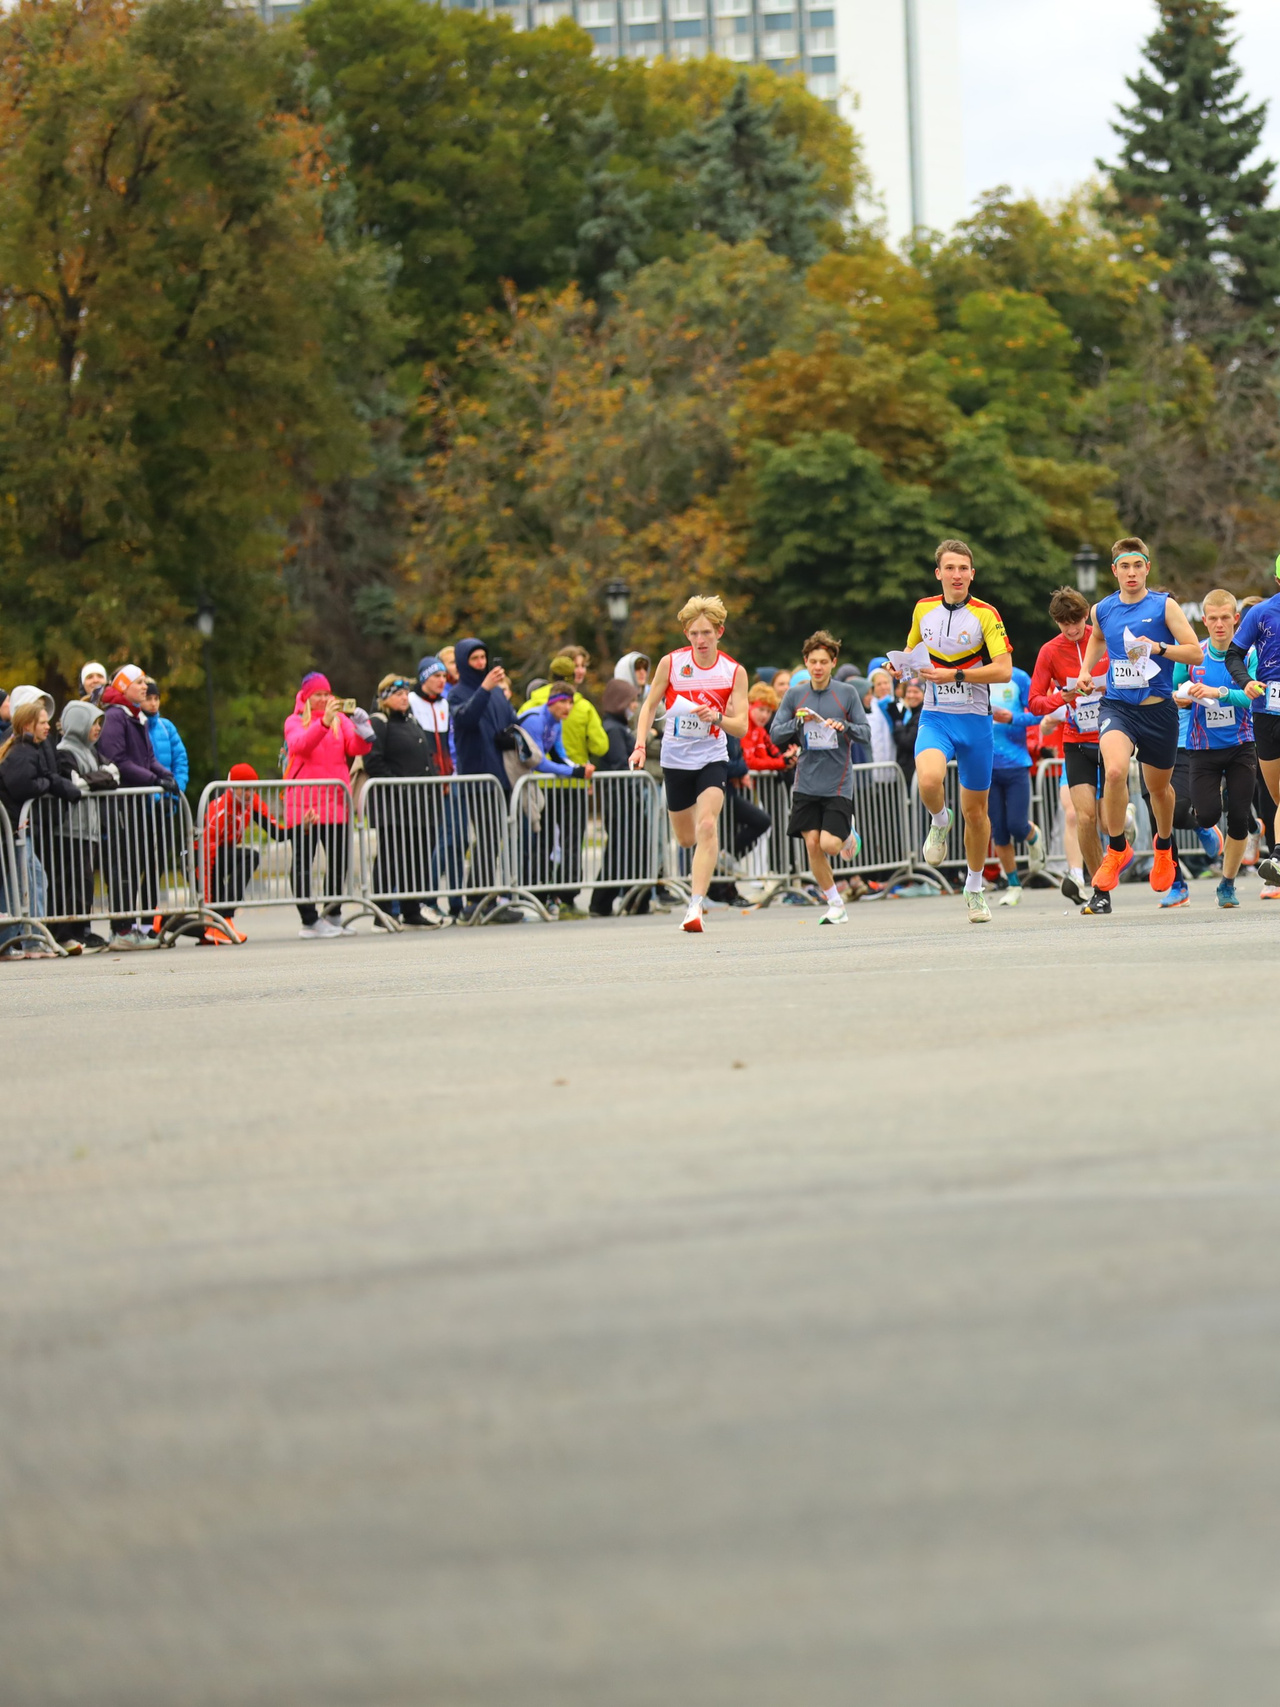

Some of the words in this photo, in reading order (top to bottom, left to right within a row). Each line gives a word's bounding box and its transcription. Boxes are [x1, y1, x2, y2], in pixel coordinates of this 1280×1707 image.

[938, 685, 965, 695] 236.1
[697, 692, 712, 707] Run
[1206, 709, 1233, 721] 225.1
